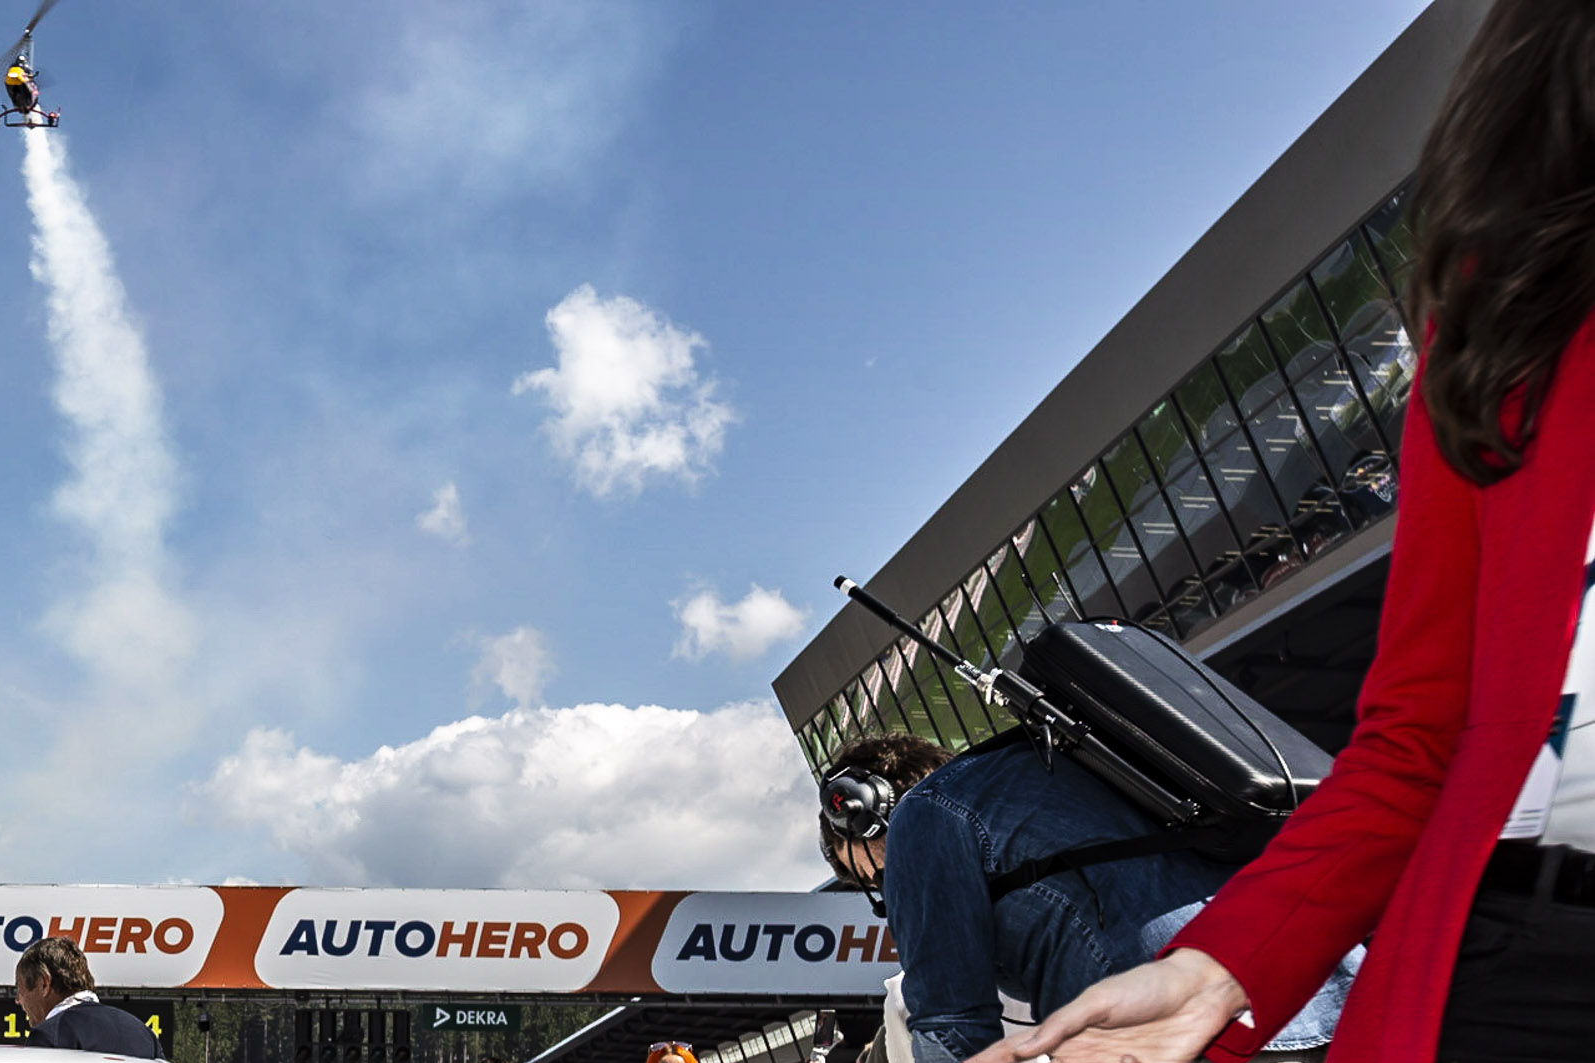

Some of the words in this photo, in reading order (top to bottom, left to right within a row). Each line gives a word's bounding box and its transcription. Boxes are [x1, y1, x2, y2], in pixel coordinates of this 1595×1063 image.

[279, 919, 589, 960] AUTOHERO
[676, 922, 899, 963] AUTOHE
[456, 1009, 507, 1026] DEKRA
